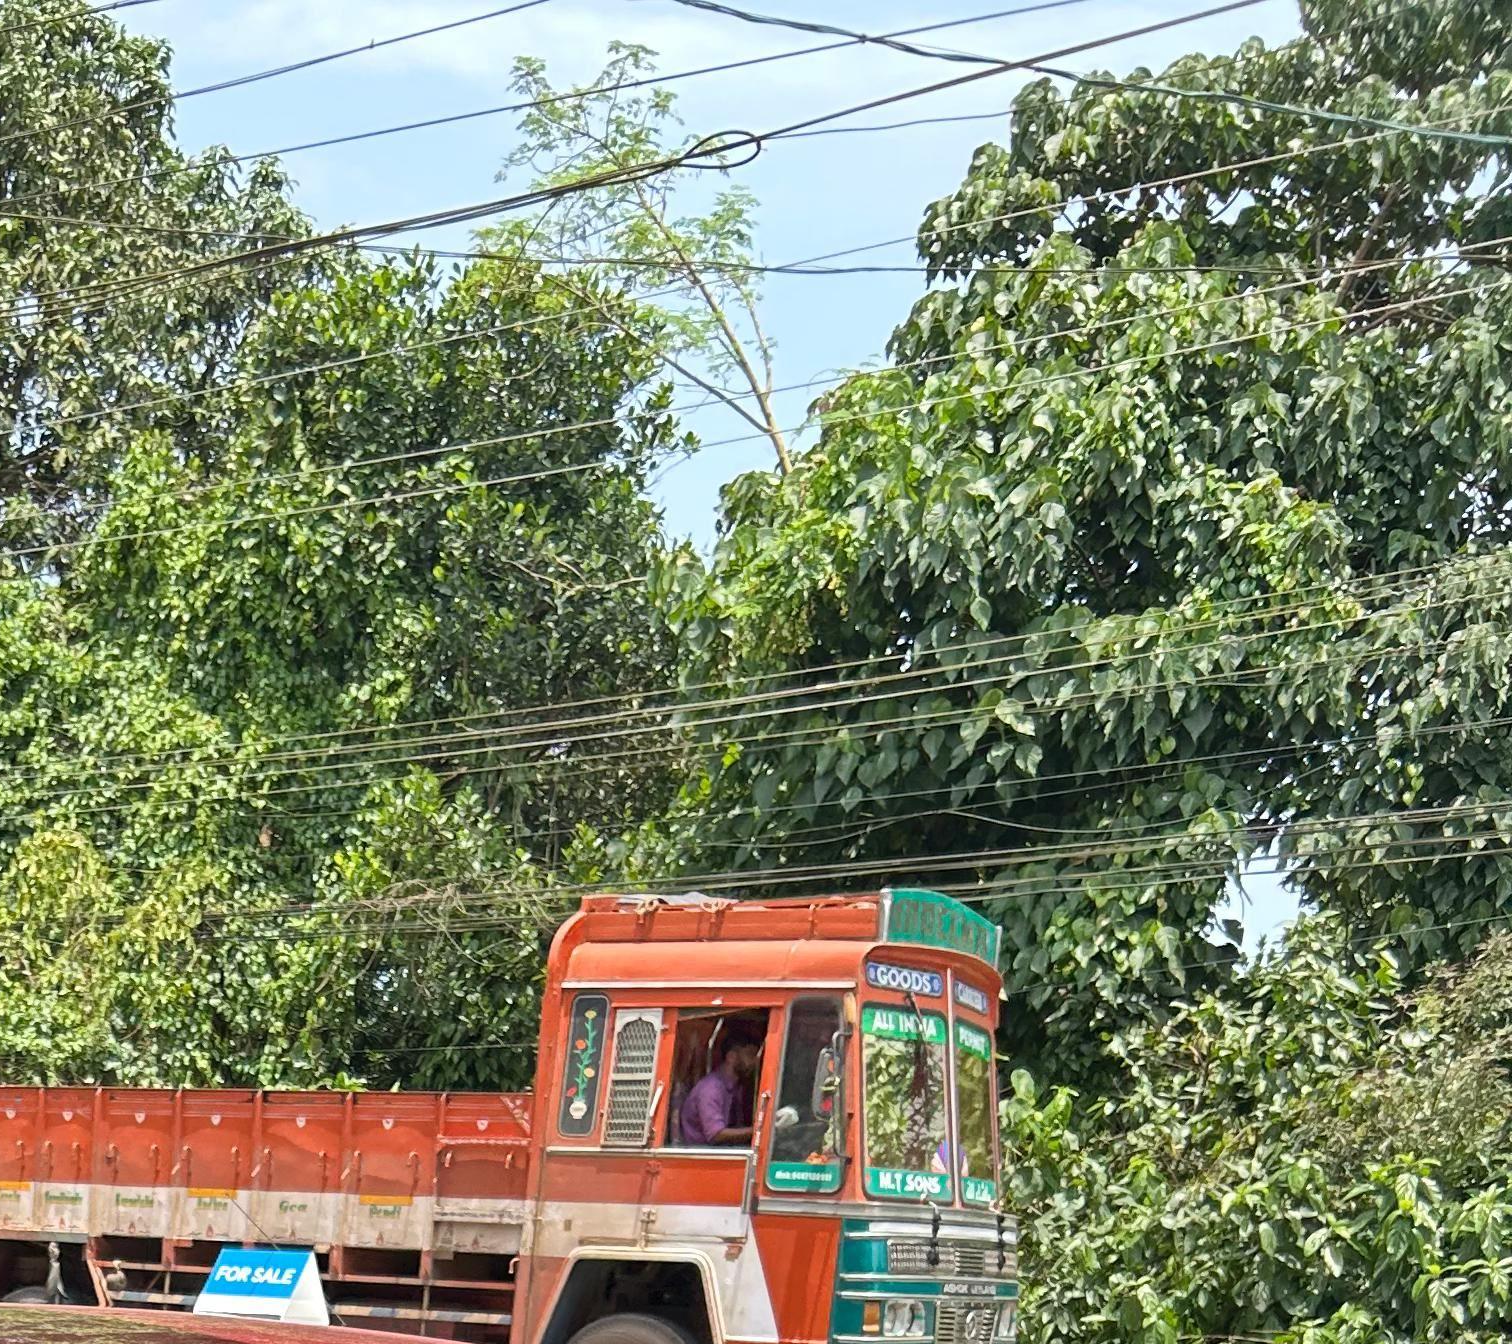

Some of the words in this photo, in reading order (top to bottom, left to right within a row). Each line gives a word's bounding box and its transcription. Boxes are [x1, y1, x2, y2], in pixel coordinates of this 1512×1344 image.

[876, 967, 931, 992] GOODS
[872, 1009, 895, 1031] ALL
[903, 1174, 941, 1194] SONS
[214, 1265, 252, 1283] FOR
[251, 1266, 297, 1285] SALE
